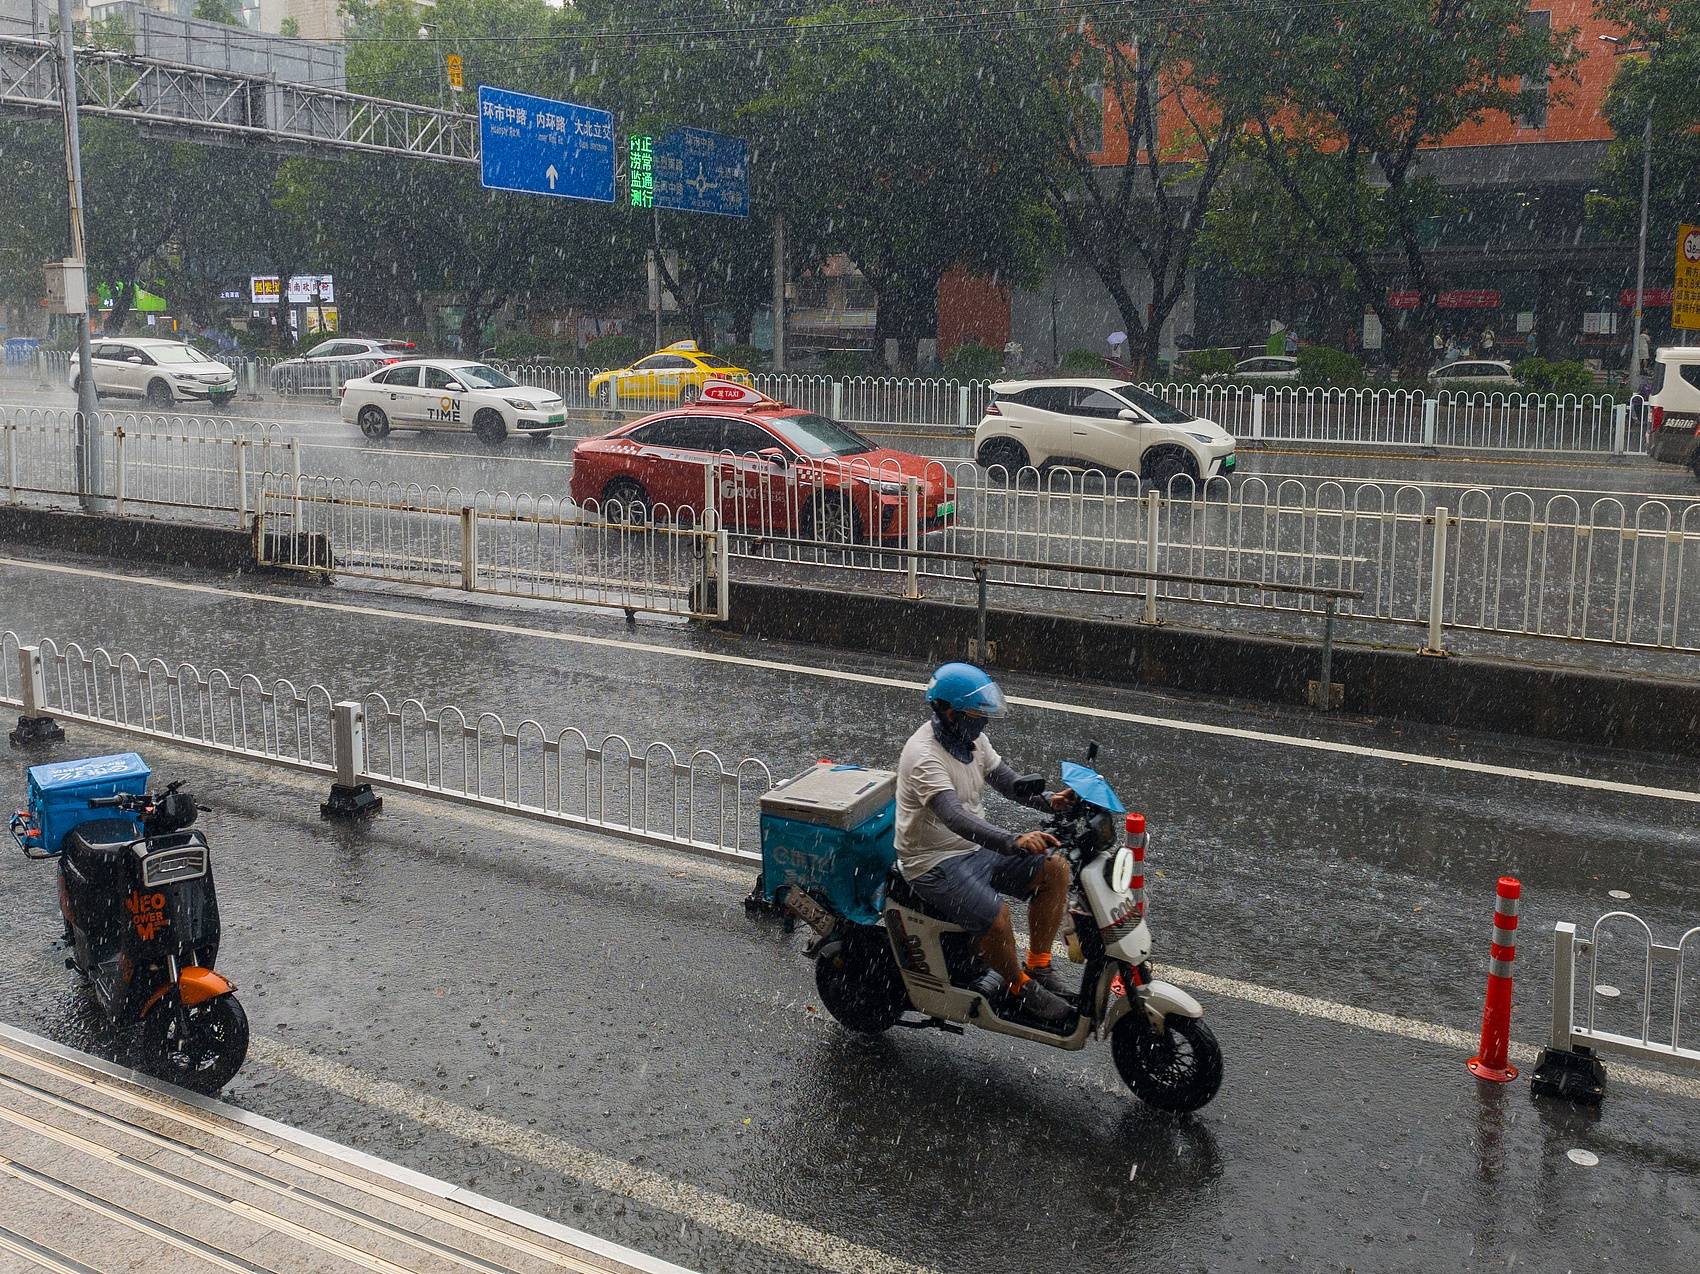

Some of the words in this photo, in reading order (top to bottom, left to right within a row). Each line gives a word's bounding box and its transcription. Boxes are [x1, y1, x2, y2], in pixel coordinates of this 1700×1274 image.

[483, 101, 528, 126] 环市中路
[536, 111, 566, 135] 内环路
[574, 118, 611, 140] 大北立交
[641, 136, 654, 209] 正常通行
[427, 408, 461, 422] TIME
